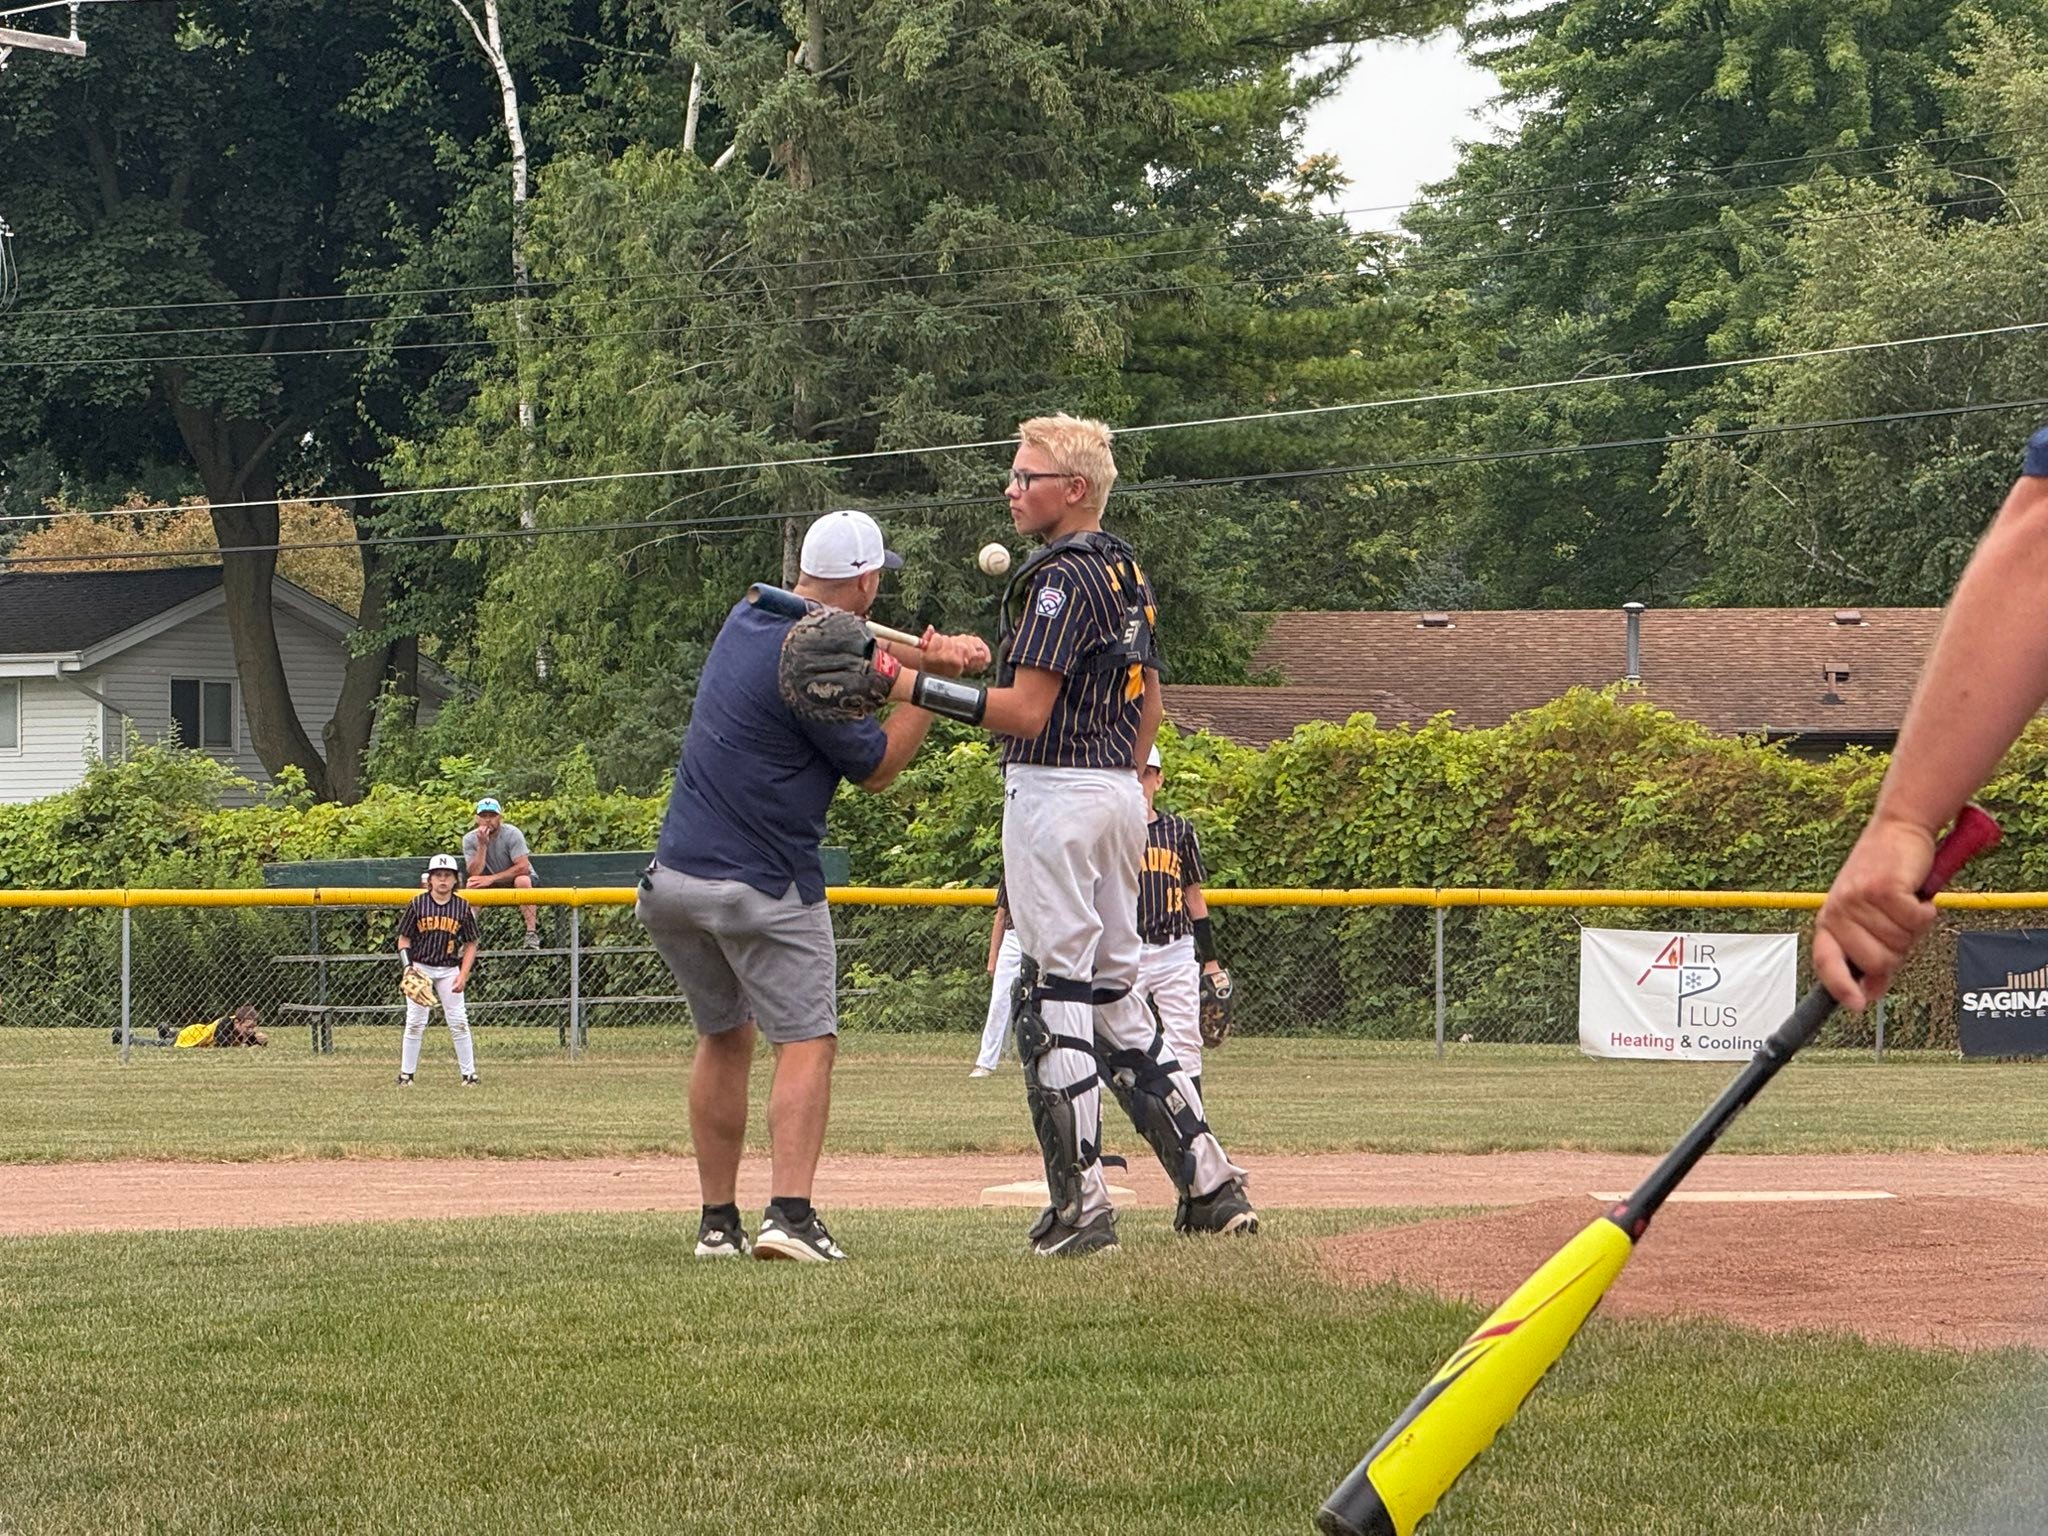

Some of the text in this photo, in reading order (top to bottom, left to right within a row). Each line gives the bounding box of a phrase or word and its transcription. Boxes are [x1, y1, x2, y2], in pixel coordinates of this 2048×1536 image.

[1167, 887, 1183, 913] 13
[1976, 1010, 2047, 1018] FENCE
[1611, 1032, 1763, 1053] Heating & Cooling
